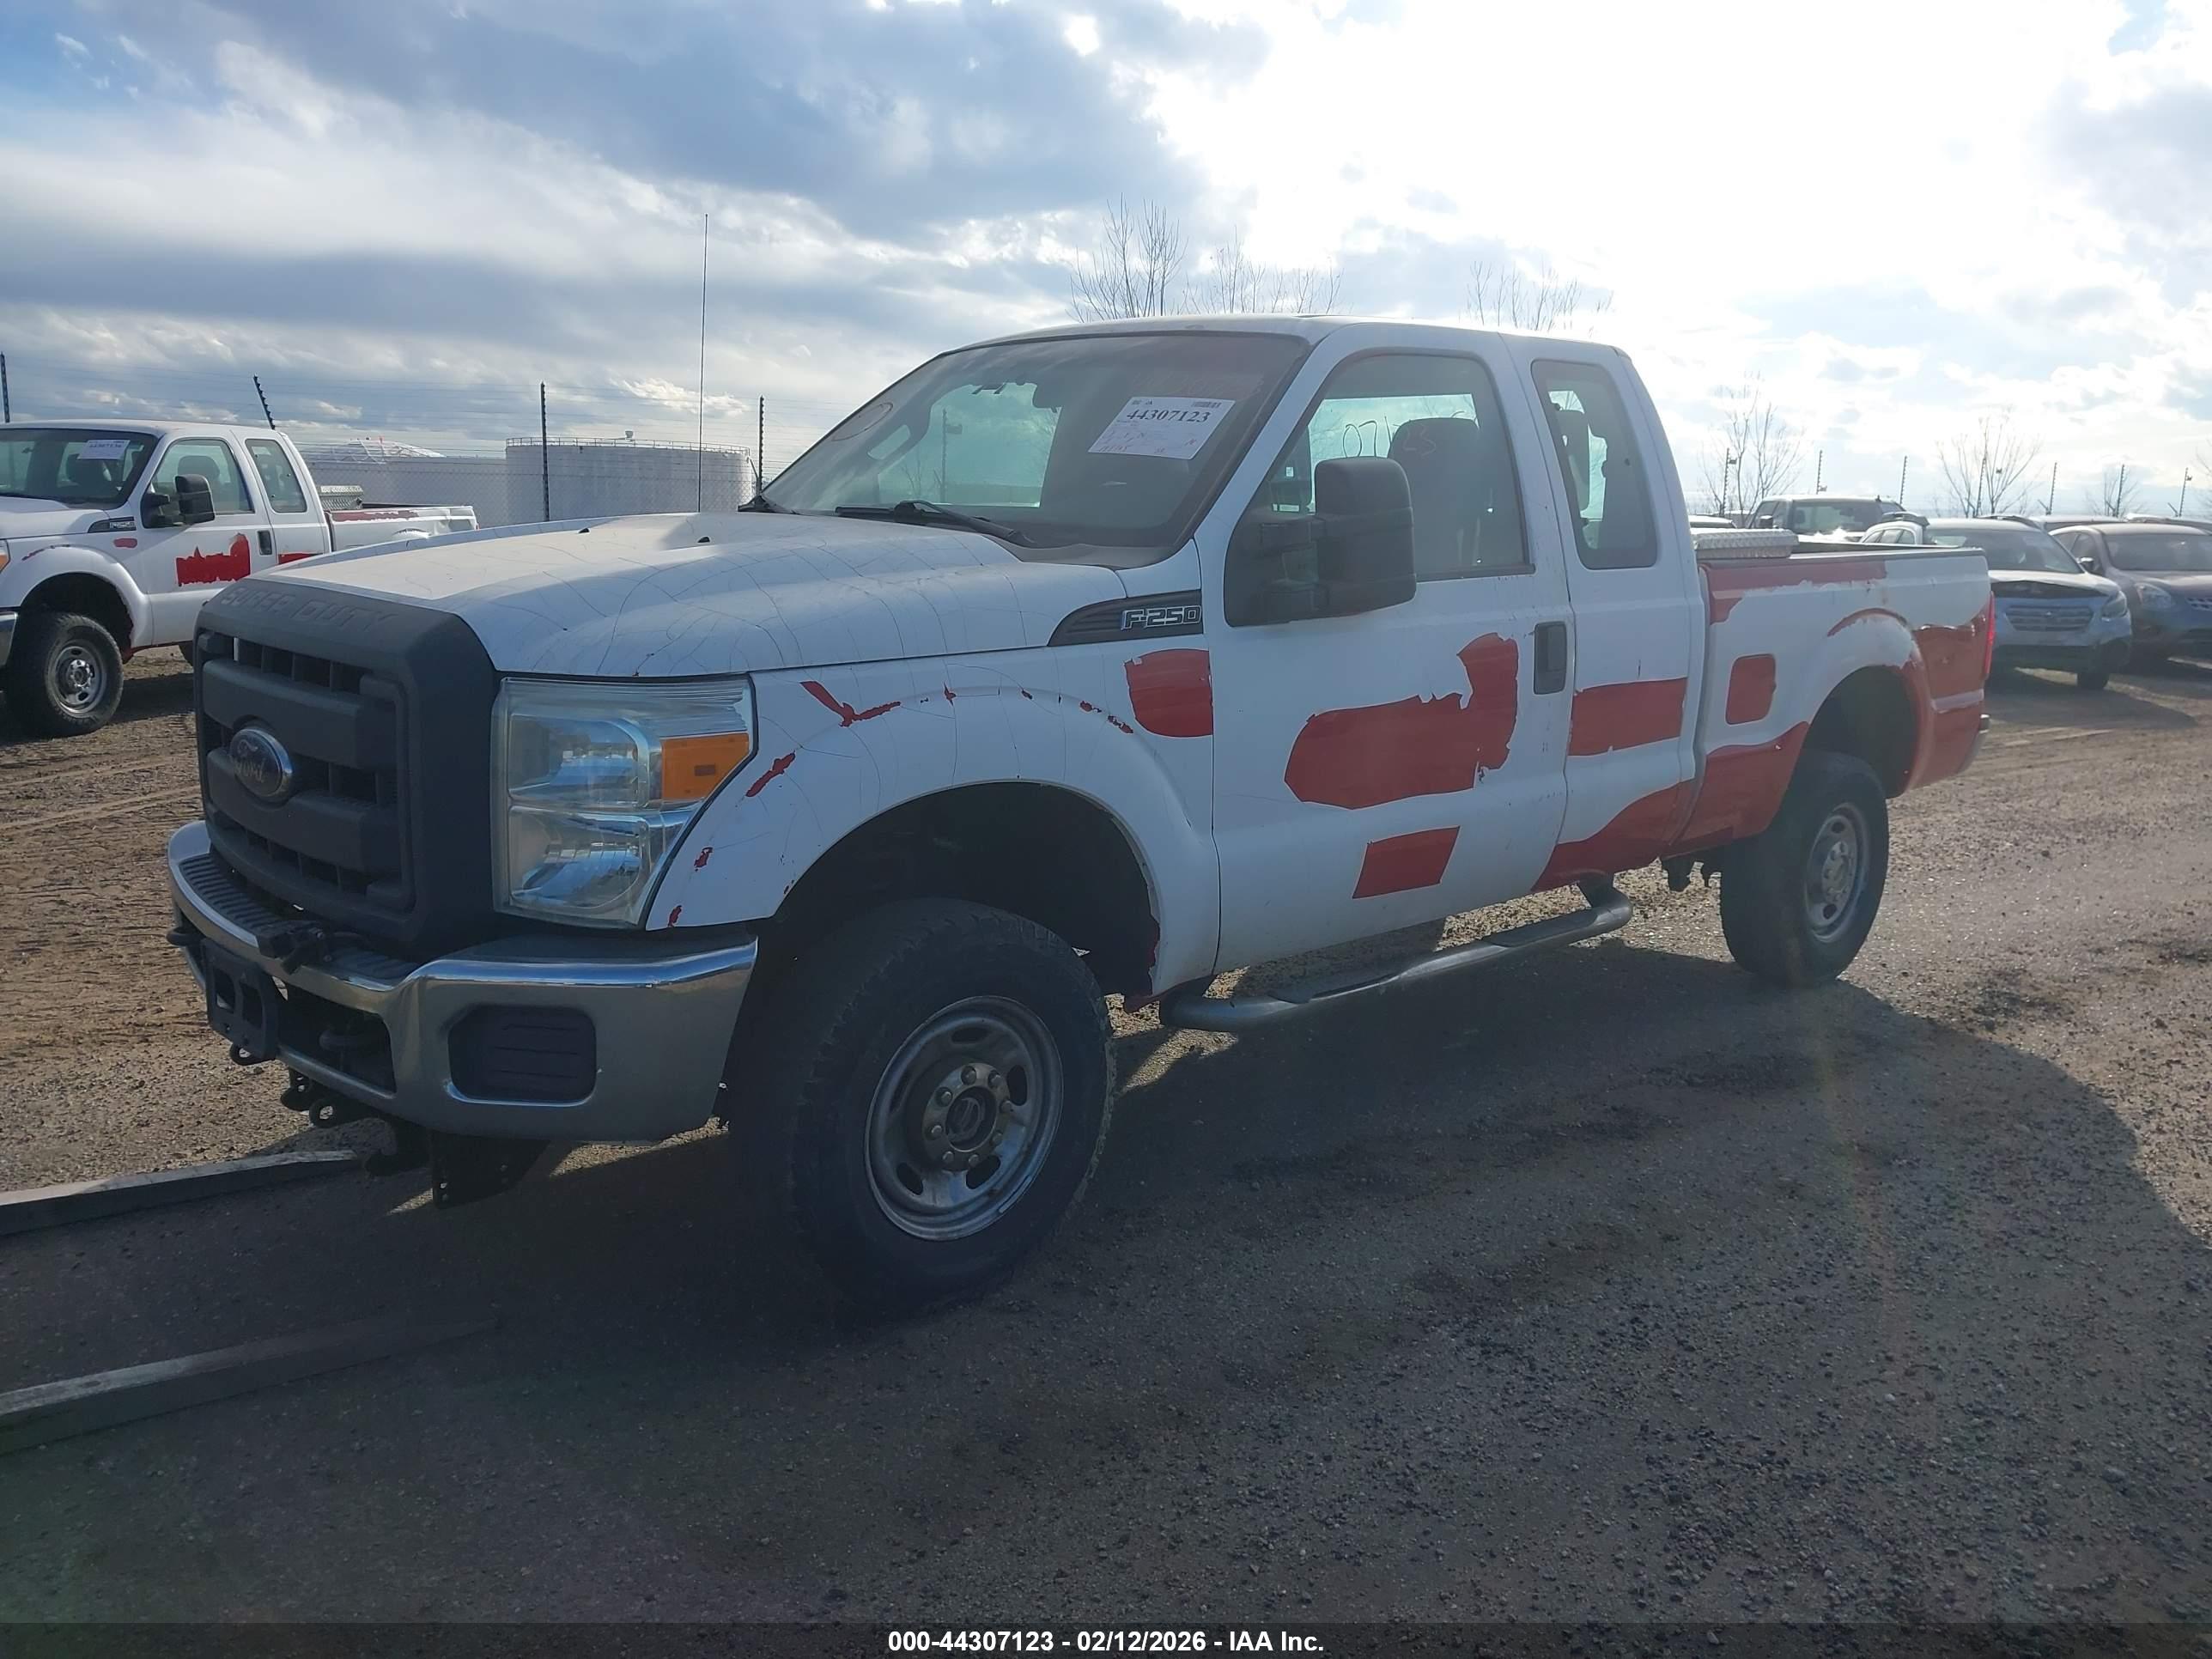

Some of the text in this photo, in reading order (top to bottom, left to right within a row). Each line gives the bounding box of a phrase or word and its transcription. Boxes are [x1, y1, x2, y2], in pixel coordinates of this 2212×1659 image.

[1126, 409, 1212, 422] 44307123
[220, 586, 398, 632] SUPER DUTY
[1121, 605, 1202, 630] F-250
